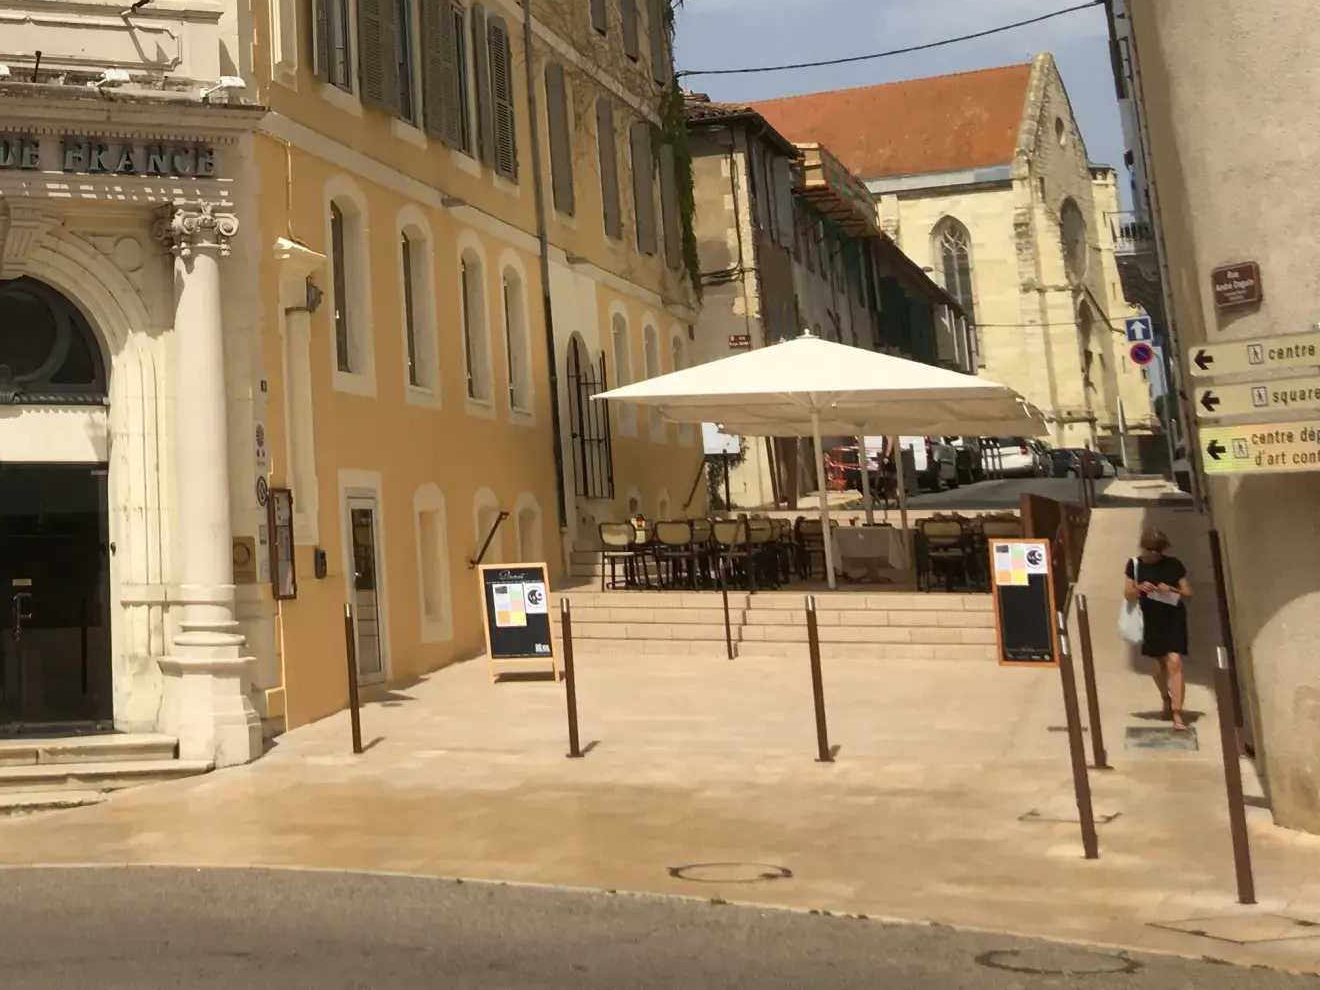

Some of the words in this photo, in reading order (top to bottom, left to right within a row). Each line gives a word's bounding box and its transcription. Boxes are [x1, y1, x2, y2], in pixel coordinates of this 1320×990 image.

[62, 140, 216, 177] FRANCE
[1226, 271, 1239, 279] Rue
[1268, 344, 1316, 361] centre
[1272, 388, 1320, 406] square
[1251, 430, 1294, 445] centre
[1255, 450, 1286, 466] d'art
